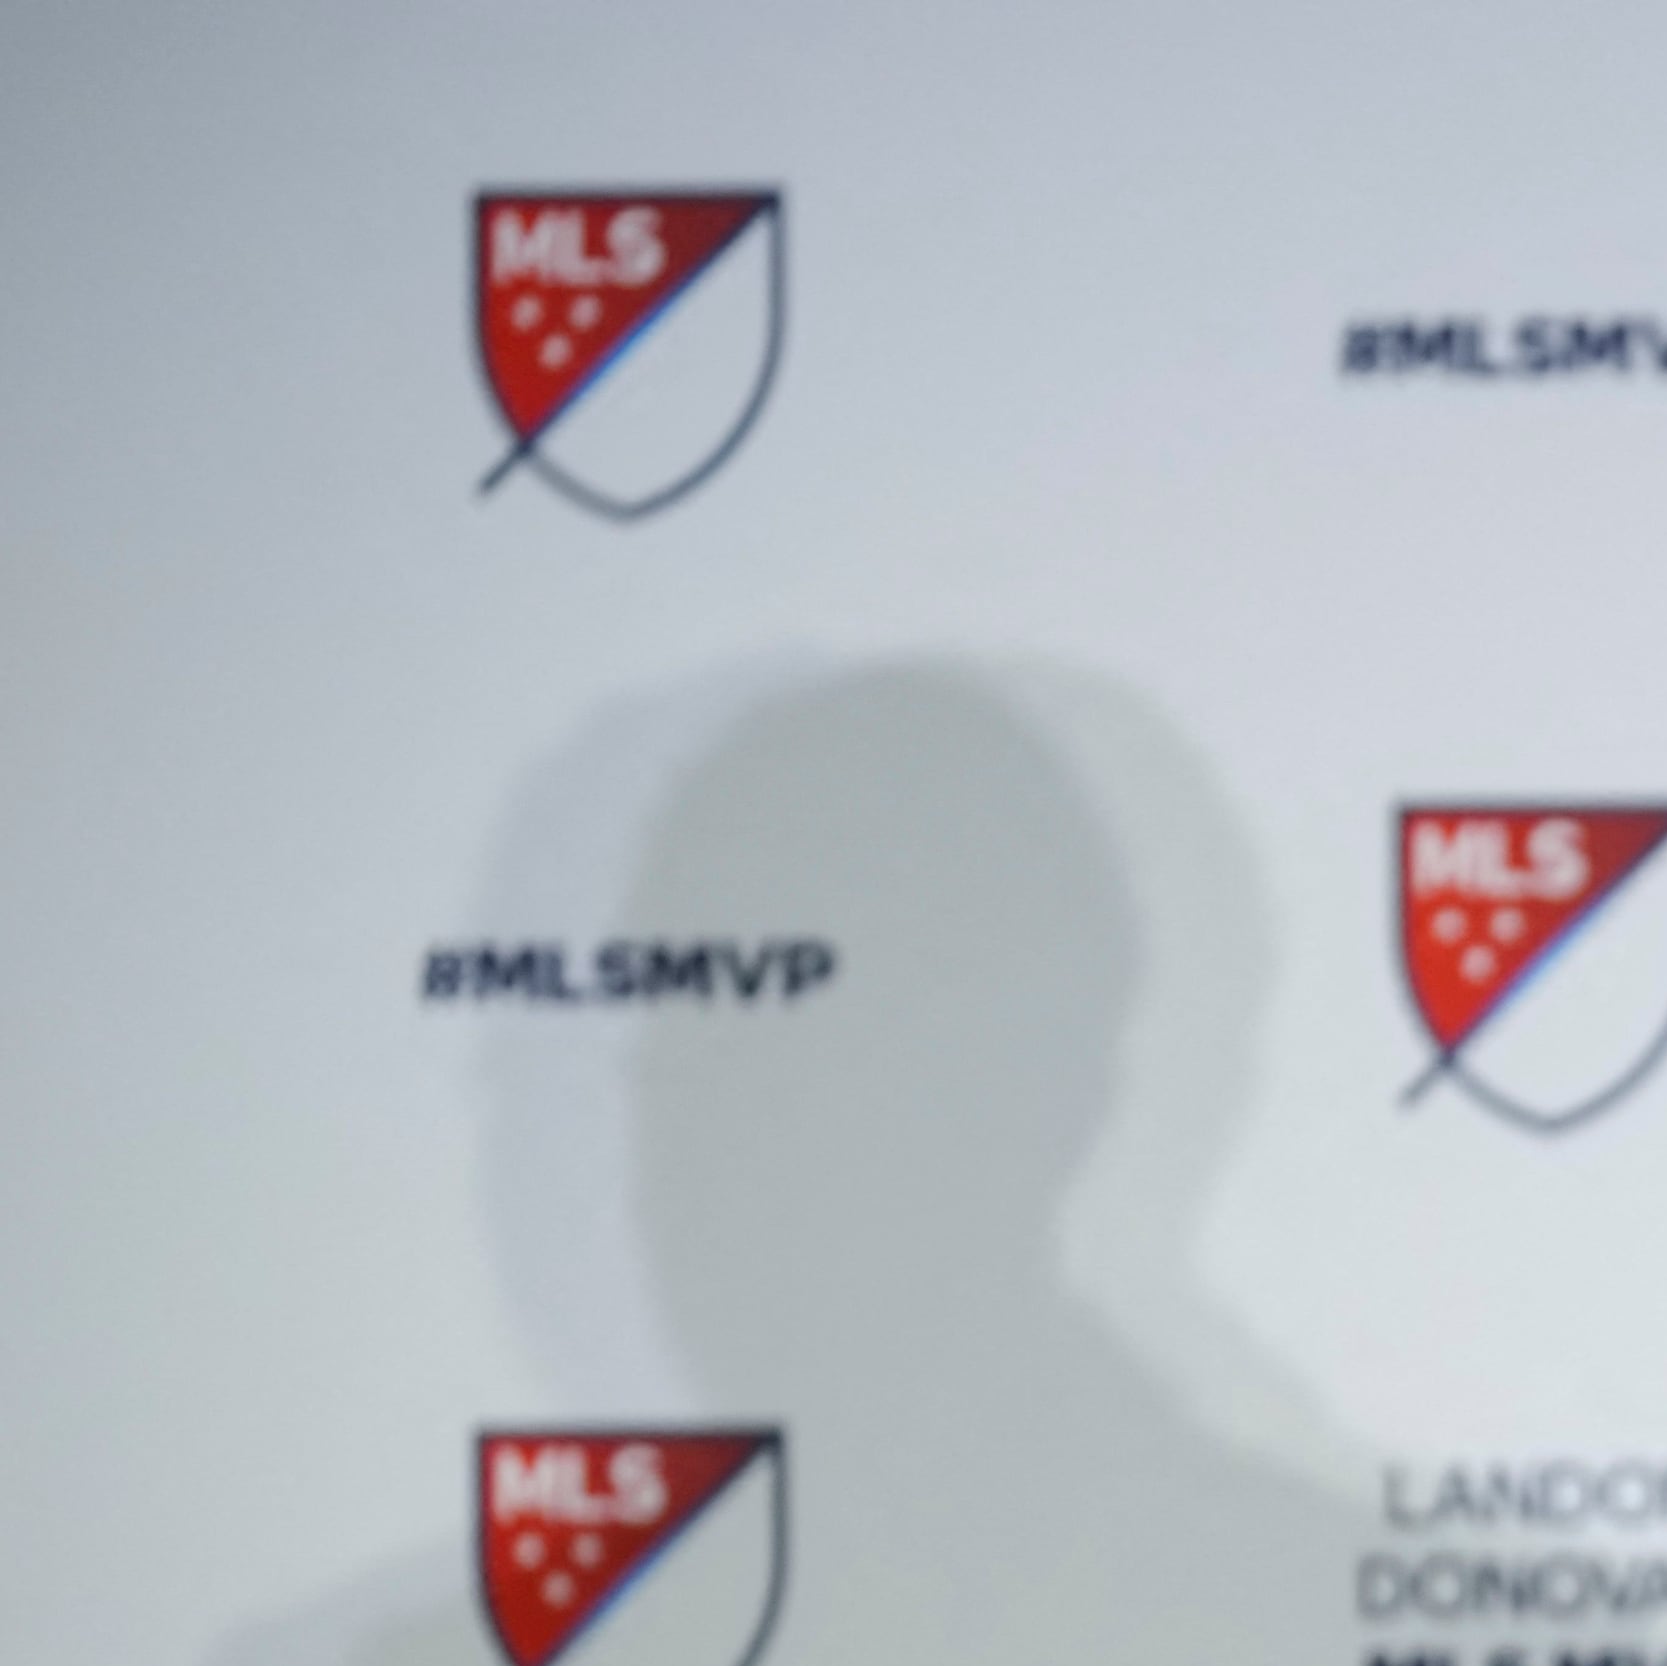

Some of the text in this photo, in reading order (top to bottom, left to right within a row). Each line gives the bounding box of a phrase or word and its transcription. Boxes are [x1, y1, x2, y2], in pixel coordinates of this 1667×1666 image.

[492, 206, 664, 284] MLS
[1410, 818, 1590, 898] MLS
[421, 938, 836, 1002] #MLSMVP
[493, 1444, 668, 1524] MLS
